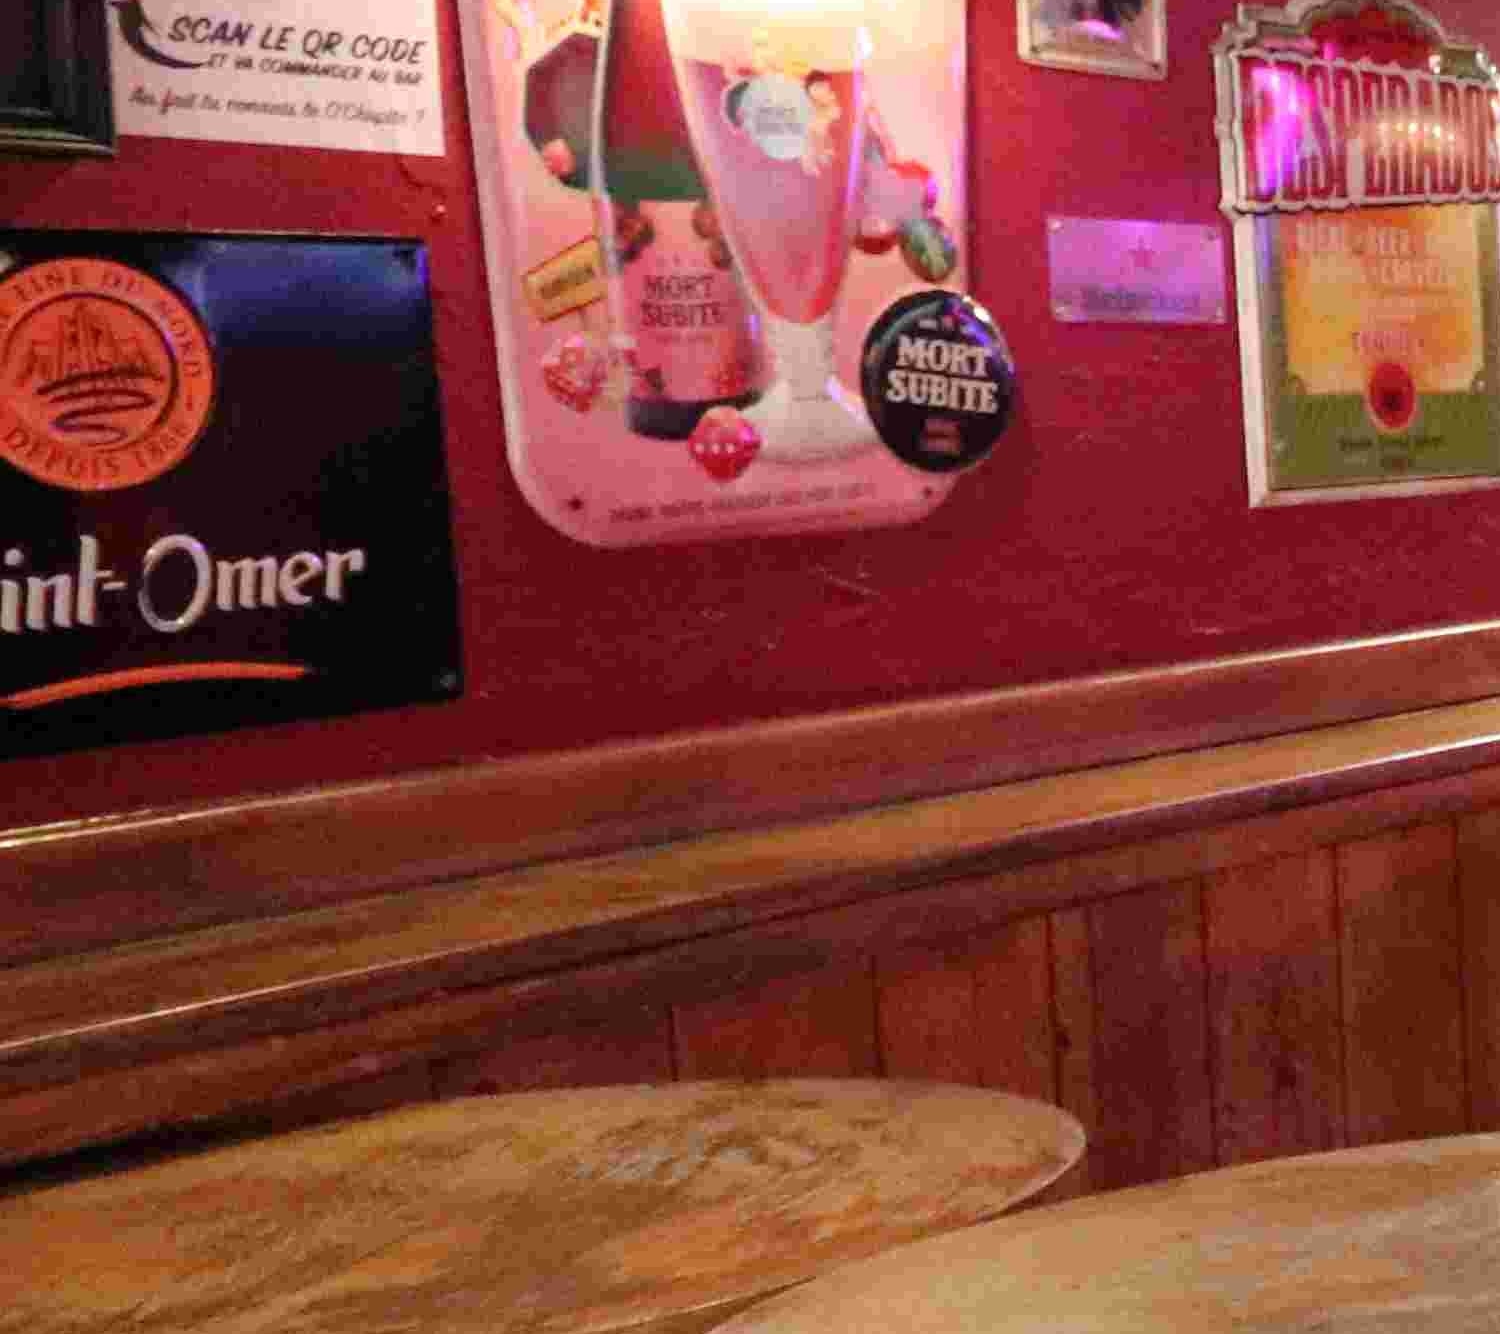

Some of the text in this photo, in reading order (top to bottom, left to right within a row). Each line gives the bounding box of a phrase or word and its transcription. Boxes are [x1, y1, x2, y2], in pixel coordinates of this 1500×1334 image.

[167, 14, 429, 65] SCAN LE QR CODE
[643, 274, 718, 300] MORT
[895, 333, 994, 376] MORT
[885, 370, 1001, 416] SUBITE
